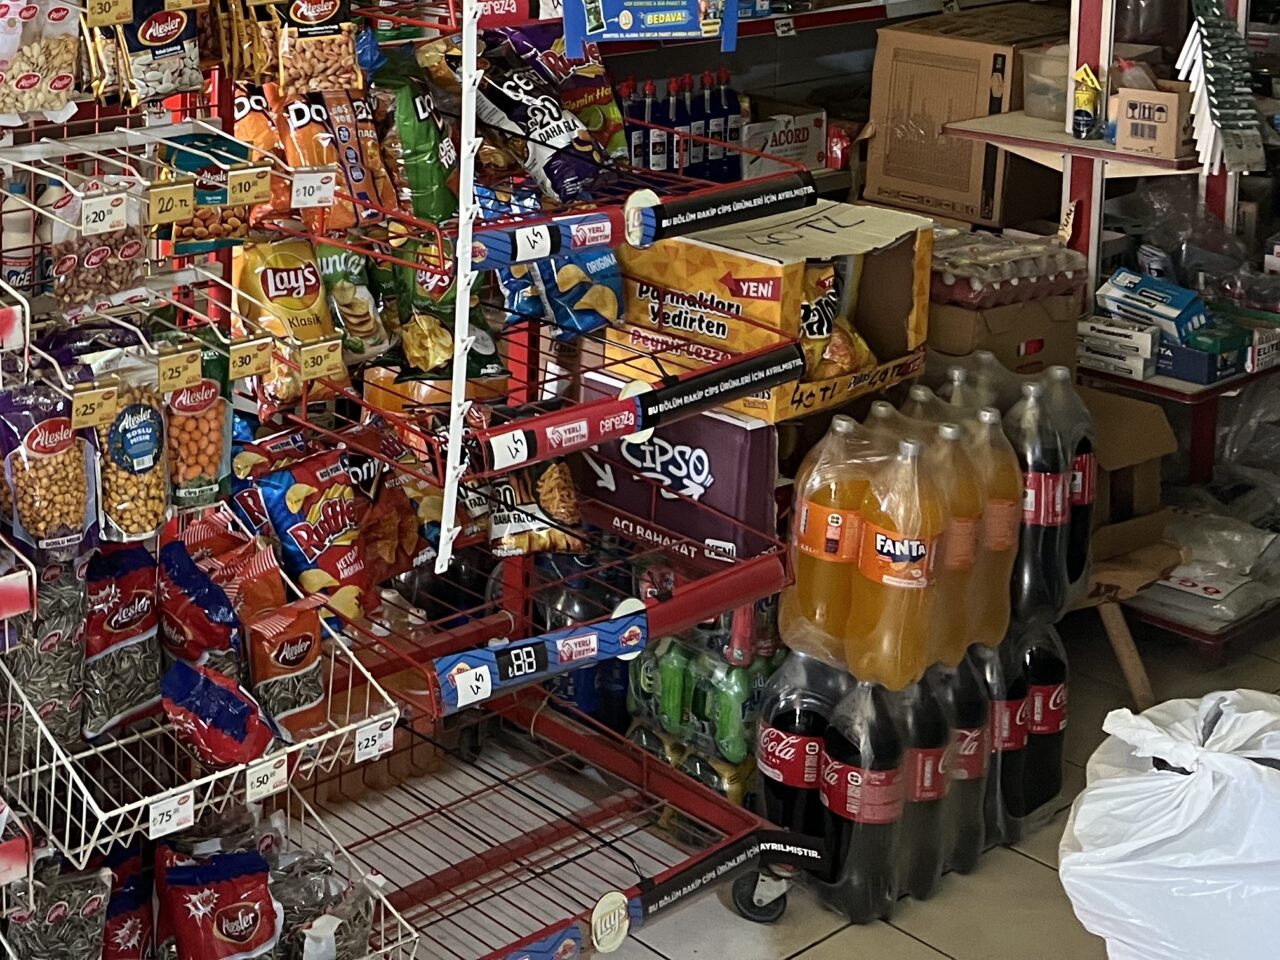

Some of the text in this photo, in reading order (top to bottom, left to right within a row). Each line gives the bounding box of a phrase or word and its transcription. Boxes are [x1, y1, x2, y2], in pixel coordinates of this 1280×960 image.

[146, 17, 181, 39] Atesler
[646, 10, 686, 26] BEDAVA!
[672, 212, 697, 227] BÖLÜM
[696, 207, 717, 222] RAKİP
[716, 204, 733, 217] CİPS
[763, 192, 778, 206] İÇİN
[7, 270, 33, 287] ACE
[266, 263, 318, 299] Lay's
[740, 280, 774, 298] YENİ
[287, 313, 322, 329] Klasik
[1088, 325, 1134, 341] Panasonic
[174, 385, 216, 409] Atesler
[647, 403, 659, 417] BU
[658, 396, 684, 416] BÖLÜM
[682, 389, 705, 407] RAKİP
[703, 385, 720, 401] CİPS
[750, 370, 766, 387] İÇİN
[118, 407, 153, 433] Atesler
[286, 496, 358, 565] Ruffle
[875, 531, 927, 559] FANTA
[573, 637, 592, 650] YERLİ
[759, 842, 821, 860] AYRILMIŞTIR.
